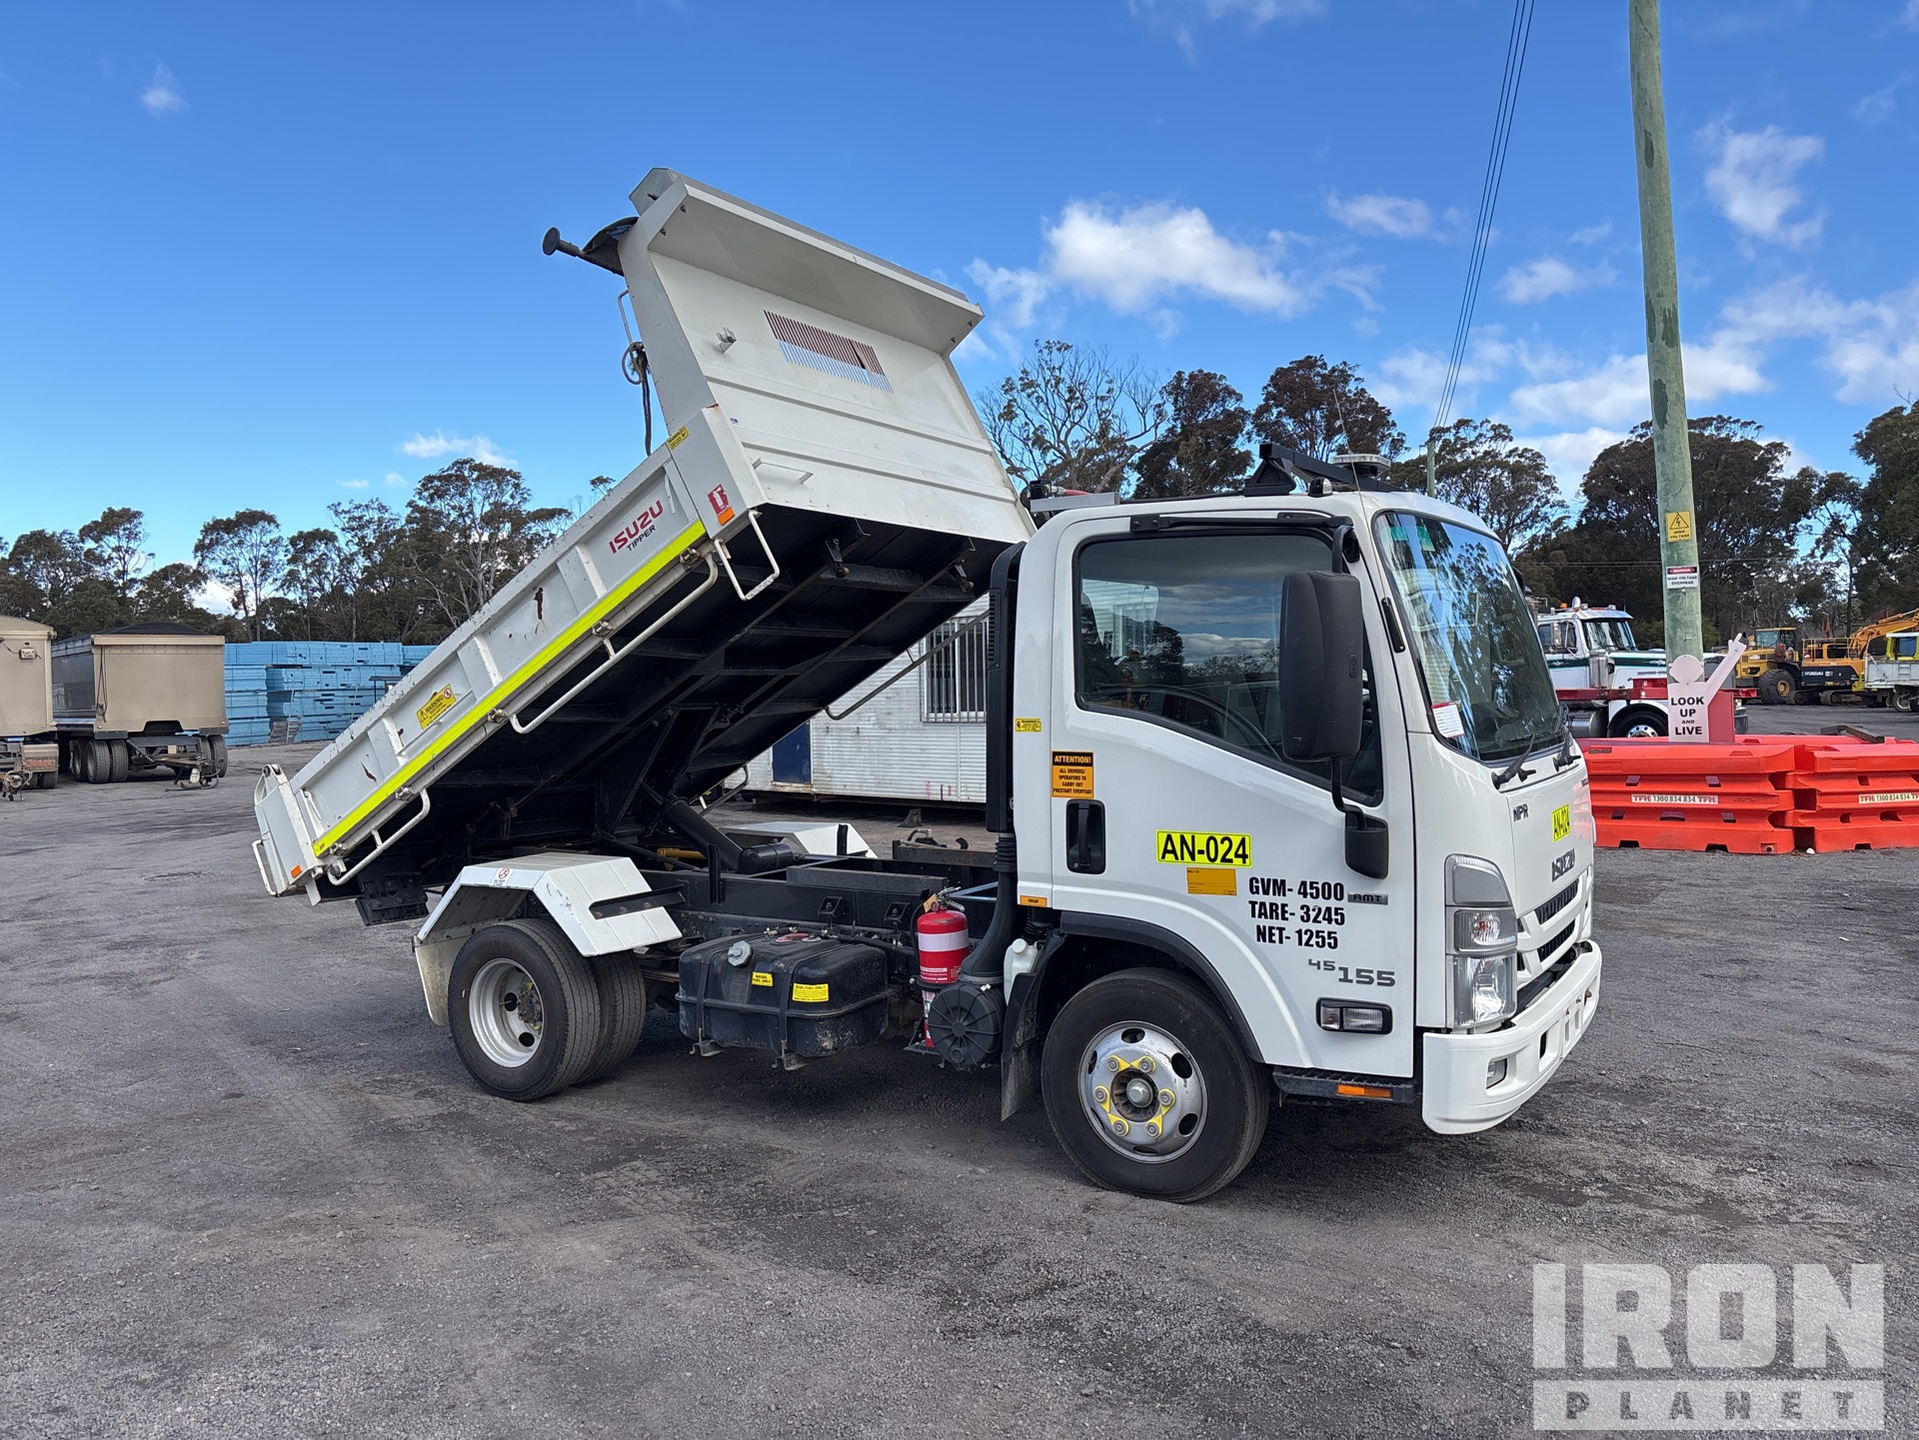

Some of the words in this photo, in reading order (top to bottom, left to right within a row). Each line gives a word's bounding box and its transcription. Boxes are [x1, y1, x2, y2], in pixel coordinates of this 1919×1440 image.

[608, 499, 664, 554] ISUZU
[626, 524, 656, 551] TIPPER
[1671, 696, 1705, 706] LOOK
[1680, 708, 1696, 718] UP
[1675, 726, 1703, 735] LIVE
[1054, 755, 1092, 764] ATTENTION!
[1513, 803, 1529, 822] NPR
[1553, 808, 1570, 838] AN-024
[1160, 833, 1248, 864] AN-024
[1551, 848, 1576, 882] ISUZU
[1248, 876, 1293, 897] GVM-
[1297, 880, 1345, 901] 4500
[1353, 893, 1382, 902] AMT
[1248, 900, 1296, 921] TARE-
[1299, 904, 1346, 926] 3245
[1256, 924, 1291, 945] NET-
[1295, 928, 1339, 949] 1255
[1308, 958, 1336, 972] 45
[1338, 966, 1396, 987] 155
